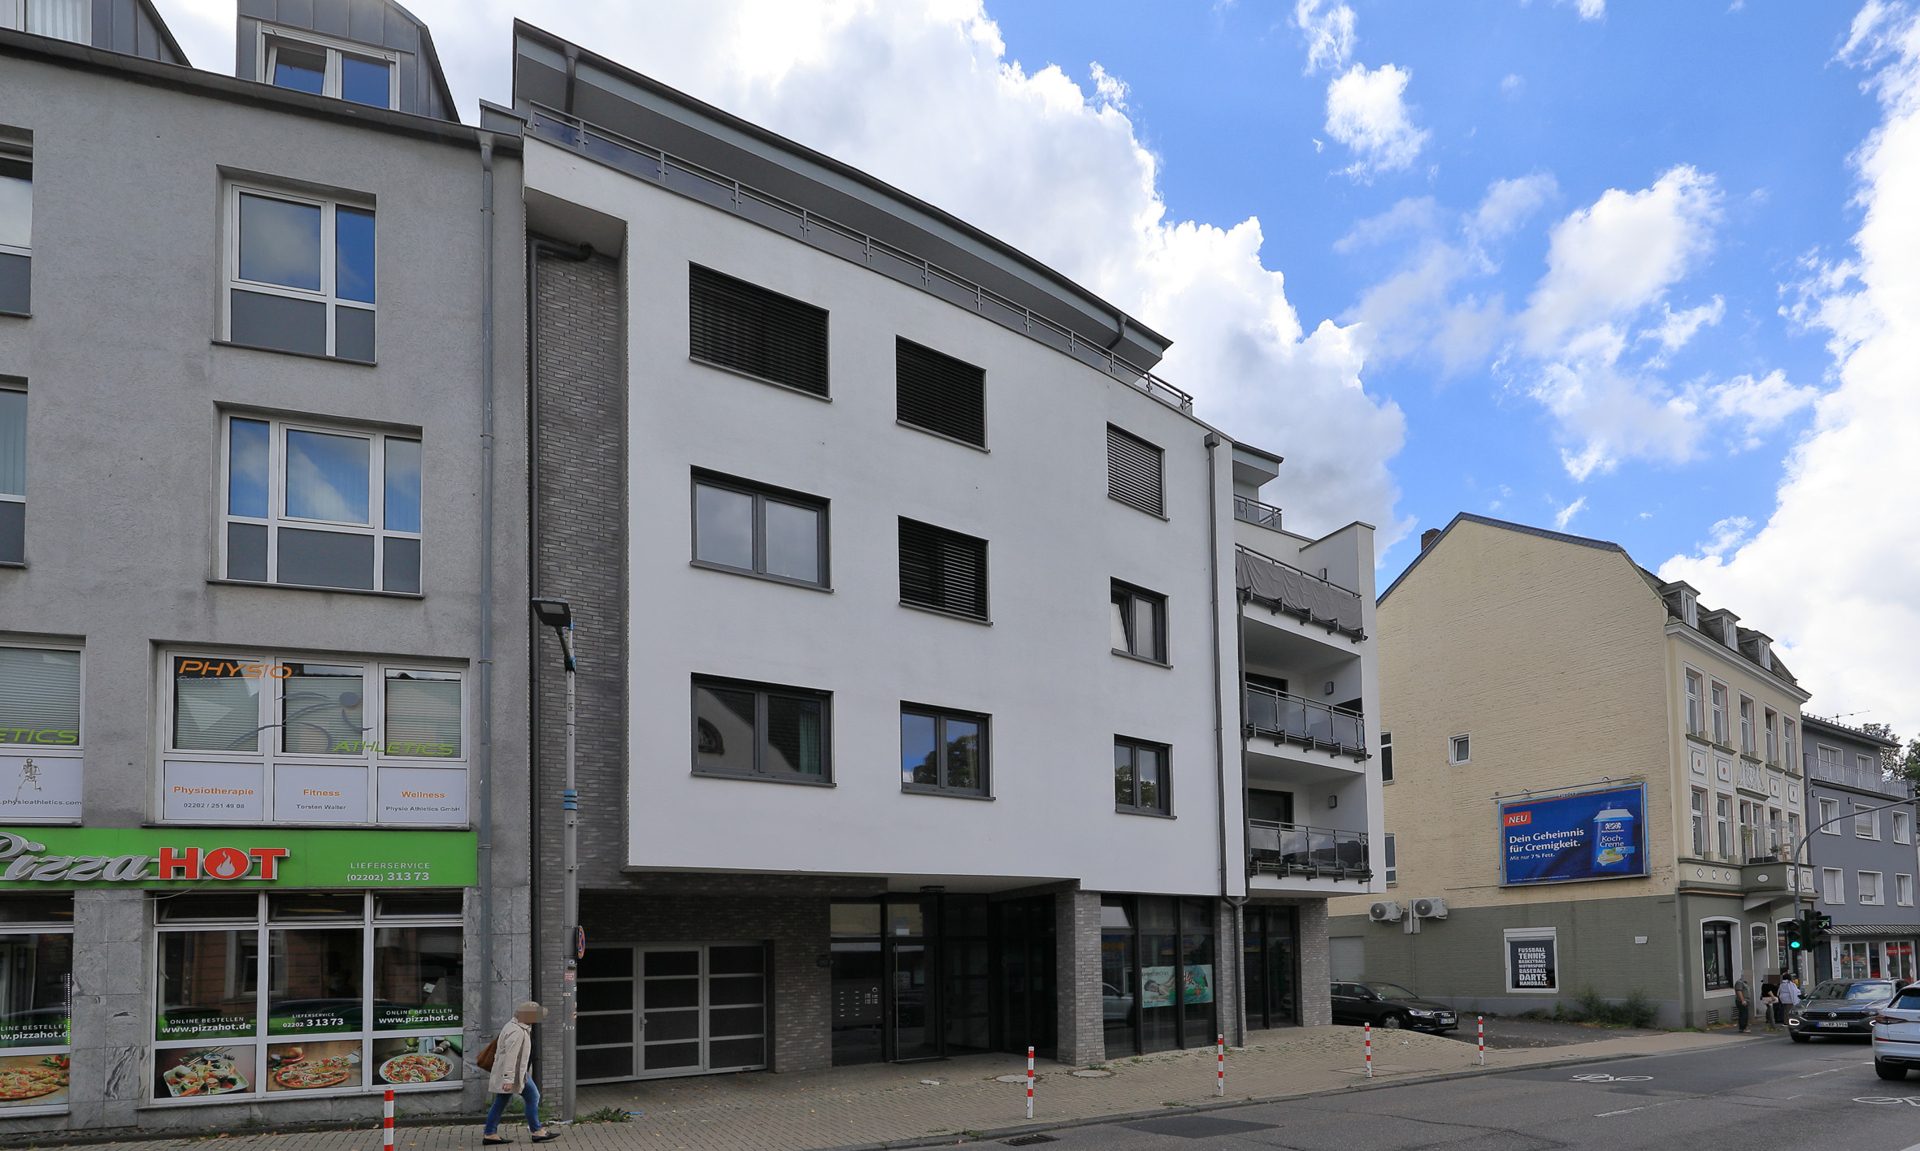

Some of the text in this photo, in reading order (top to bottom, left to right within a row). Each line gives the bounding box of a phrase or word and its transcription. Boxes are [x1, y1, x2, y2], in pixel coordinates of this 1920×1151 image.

[178, 660, 293, 679] PHYSIO
[333, 740, 454, 756] ATHLETICS
[173, 785, 254, 796] Physiotherapie
[303, 789, 341, 797] Fitness
[401, 791, 446, 799] Wellness
[1508, 815, 1527, 824] NEU
[1509, 828, 1585, 844] Dein Geheimnis
[1509, 839, 1581, 853] für Cremigkeit.
[159, 847, 290, 880] HOT
[346, 873, 384, 882] (02202)
[378, 1014, 459, 1024] www.pizzahot.de
[162, 1022, 252, 1033] www.pizzahot.de
